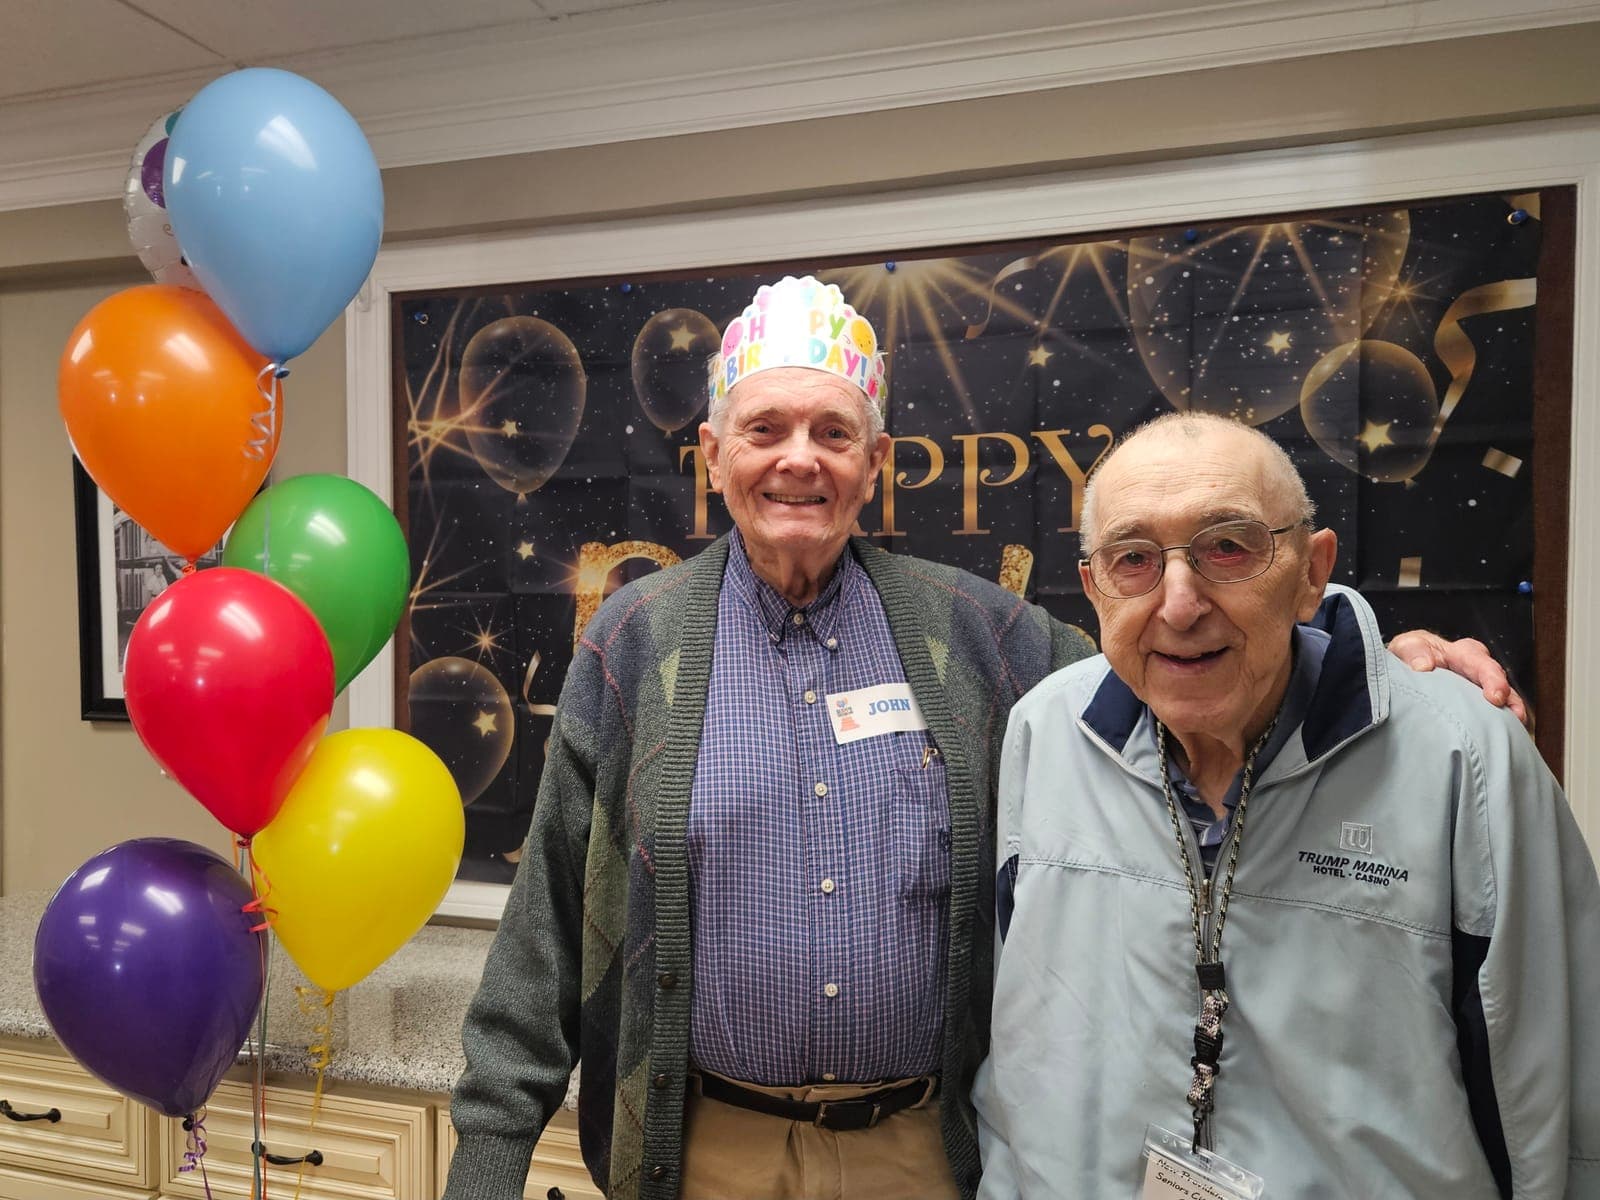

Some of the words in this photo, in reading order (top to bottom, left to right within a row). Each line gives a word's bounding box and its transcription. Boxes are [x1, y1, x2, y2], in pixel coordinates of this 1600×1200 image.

[749, 309, 847, 343] HPY
[726, 337, 868, 388] BIRDAY!
[679, 424, 1114, 540] PPY
[868, 698, 911, 716] JOHN
[1298, 851, 1350, 868] TRUMP
[1352, 860, 1409, 882] MARINA
[1313, 865, 1345, 878] HOTEL
[1355, 872, 1390, 887] CASINO
[1155, 1171, 1189, 1195] Seniors
